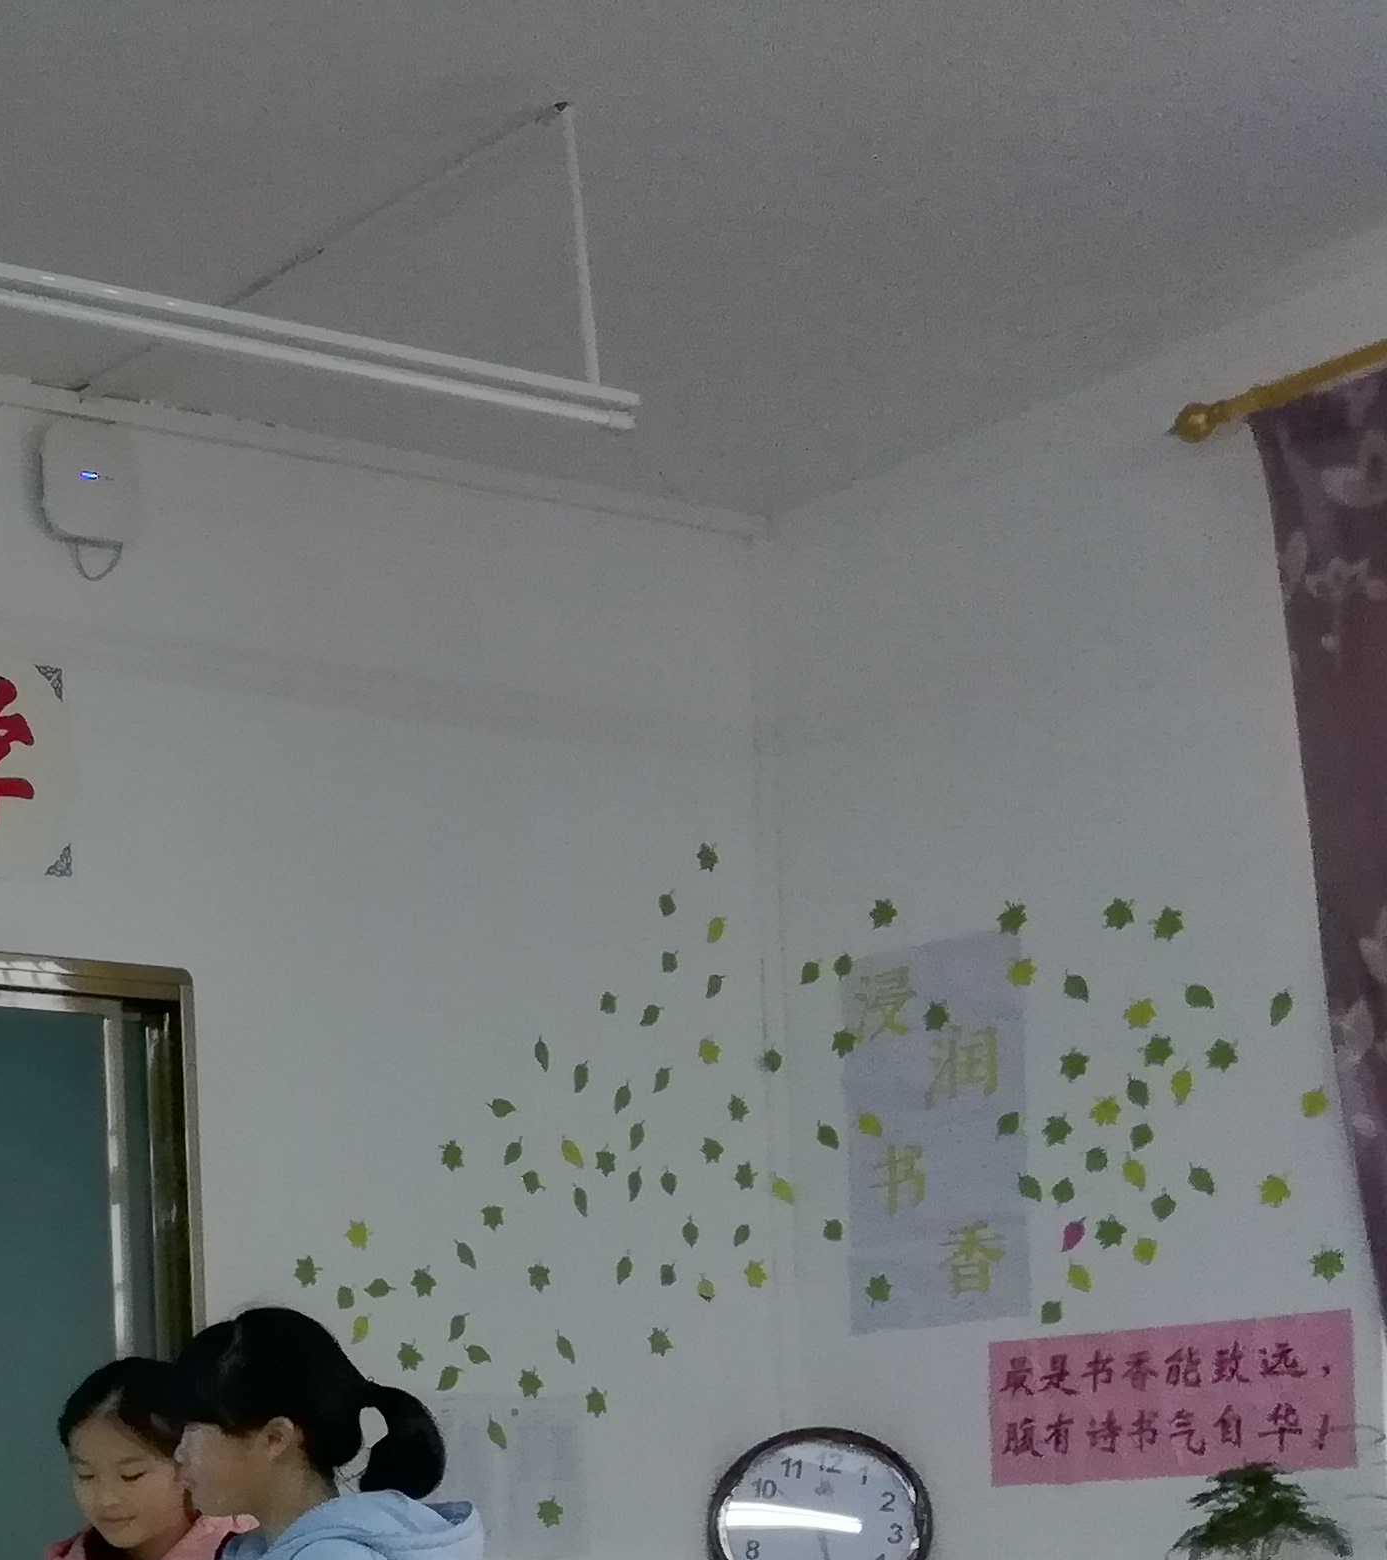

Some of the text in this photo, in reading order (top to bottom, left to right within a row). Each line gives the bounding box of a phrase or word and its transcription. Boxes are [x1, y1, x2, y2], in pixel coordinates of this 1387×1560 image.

[781, 1458, 803, 1479] 11
[752, 1478, 777, 1499] 10
[879, 1491, 896, 1512] 2
[887, 1523, 903, 1544] 3
[745, 1540, 760, 1560] 8
